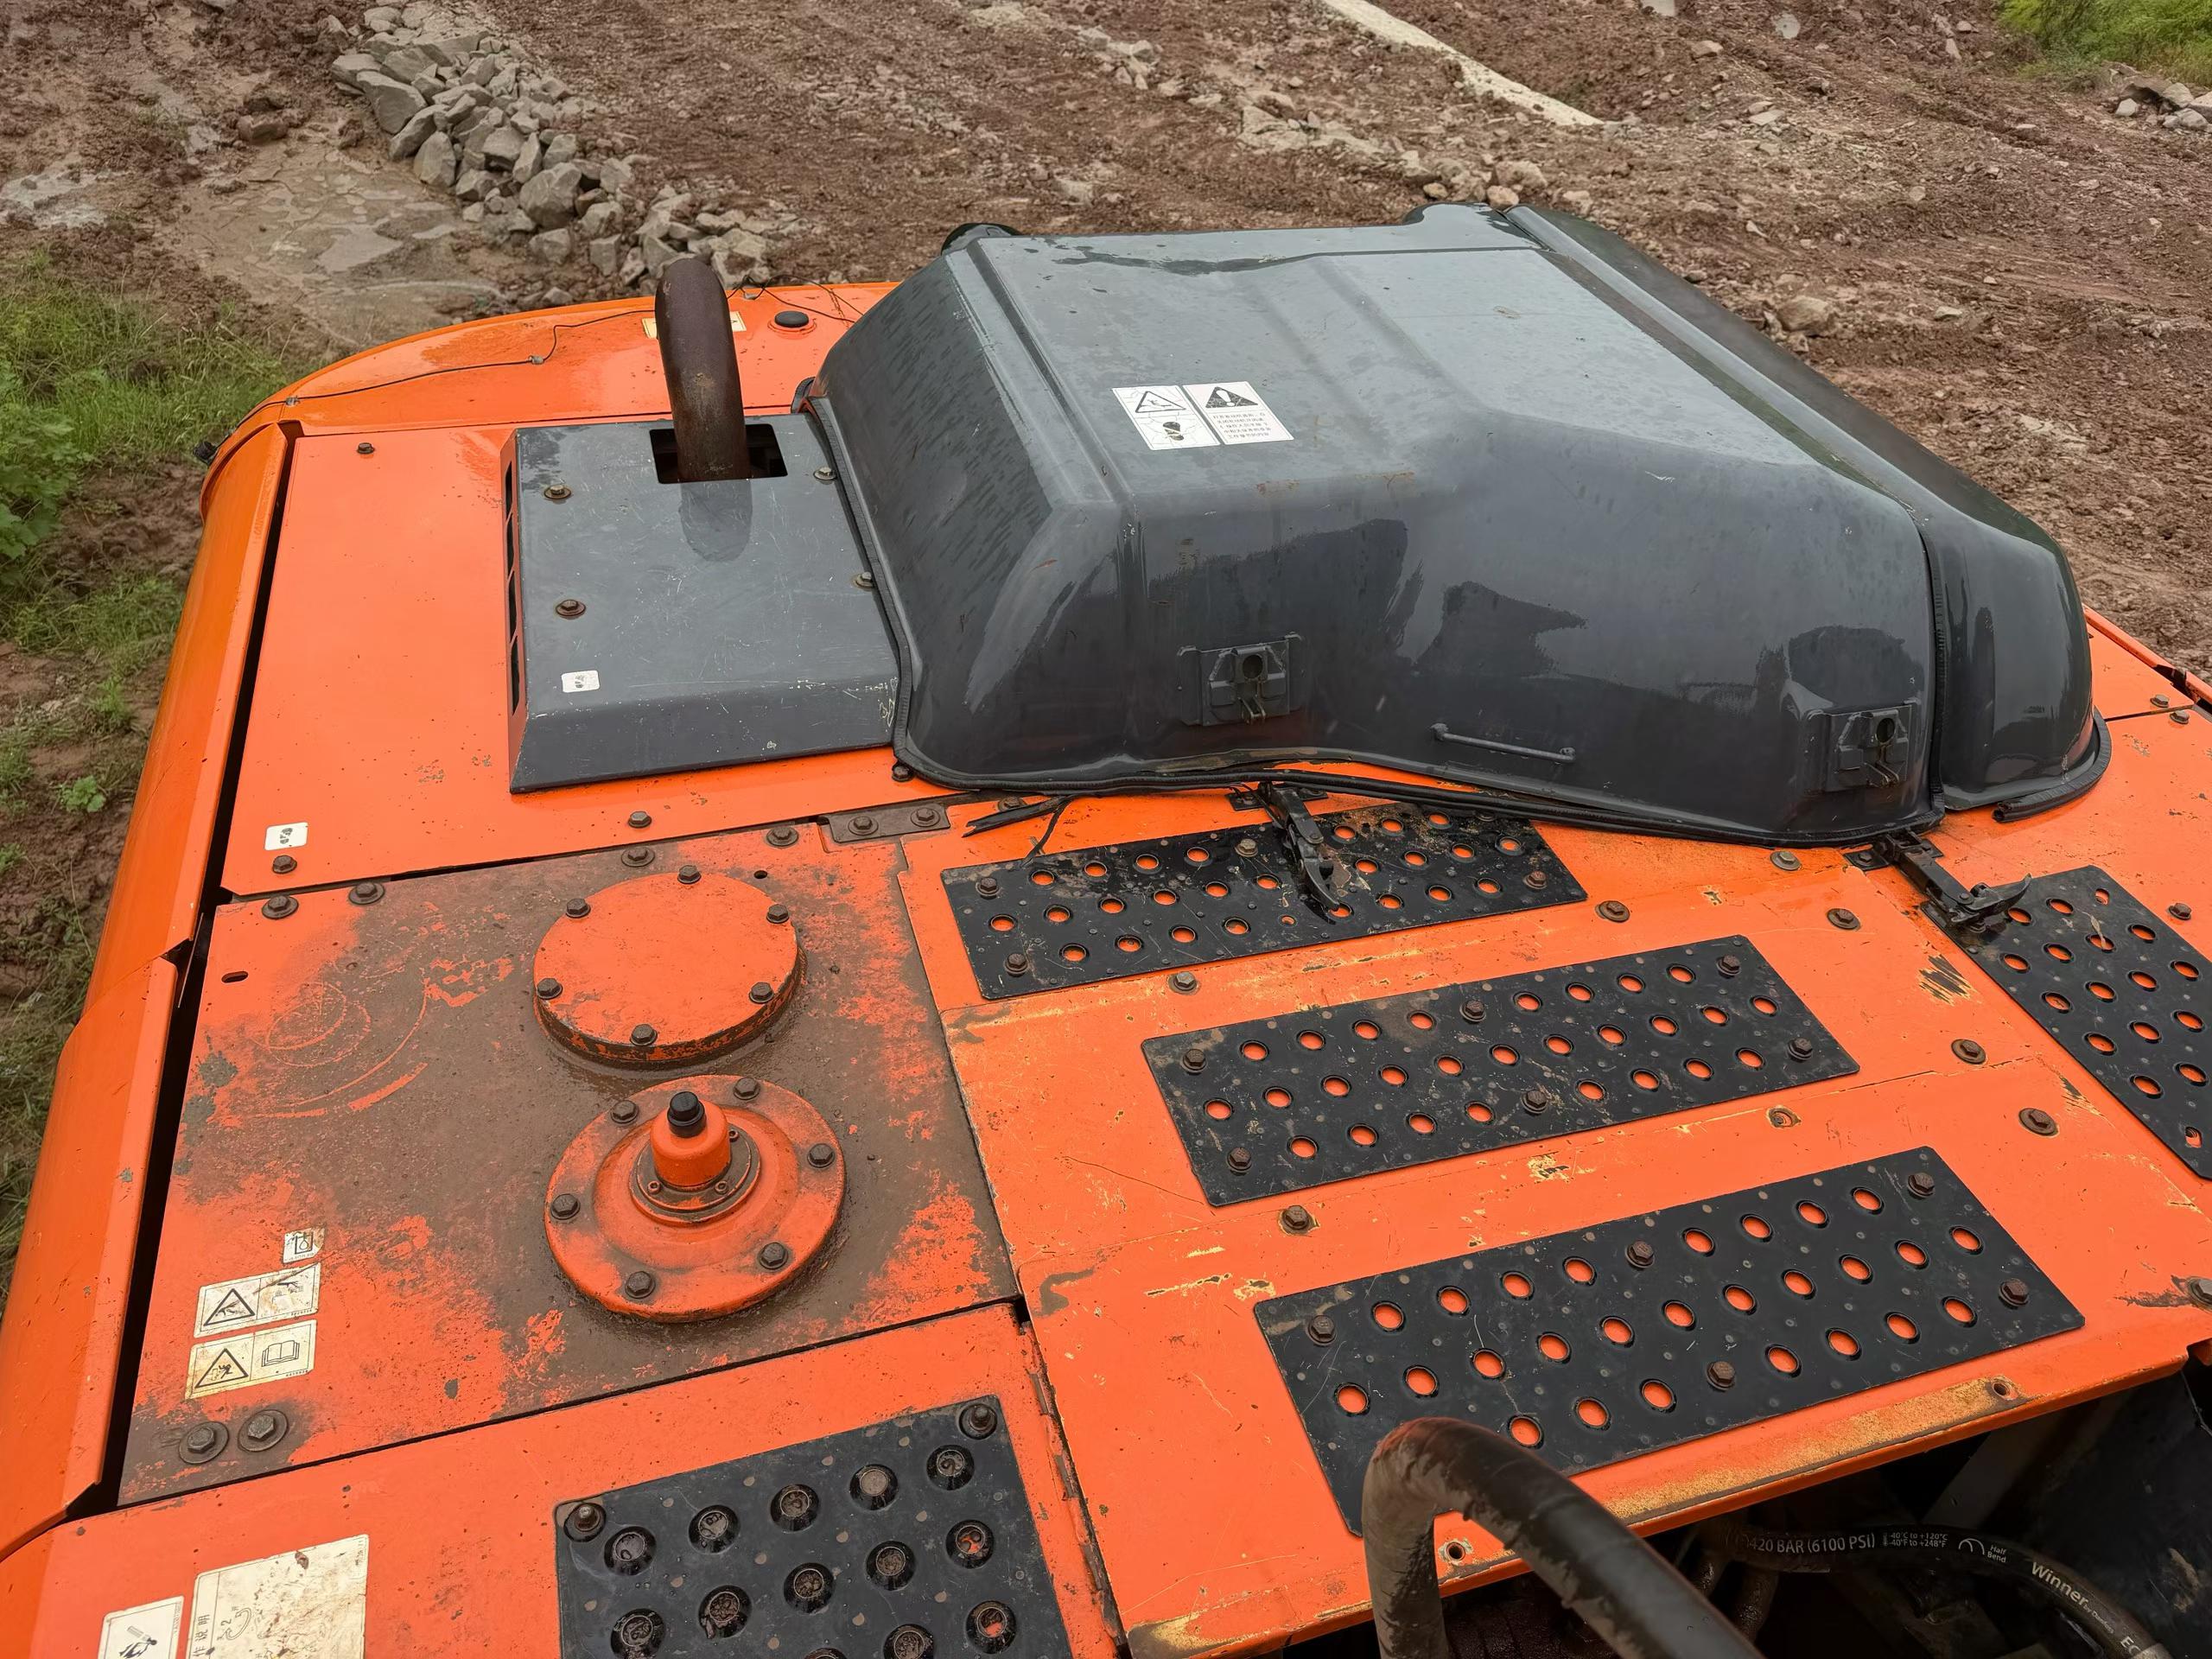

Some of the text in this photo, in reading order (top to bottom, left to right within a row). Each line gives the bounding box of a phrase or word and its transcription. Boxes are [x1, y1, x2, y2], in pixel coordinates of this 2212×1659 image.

[1777, 1539, 1805, 1554] BAR
[1807, 1537, 1846, 1554] (6100
[1849, 1532, 1875, 1550] PSI)
[1990, 1544, 2007, 1555] Half
[1987, 1550, 2007, 1563] Bend
[2031, 1561, 2089, 1606] Winner
